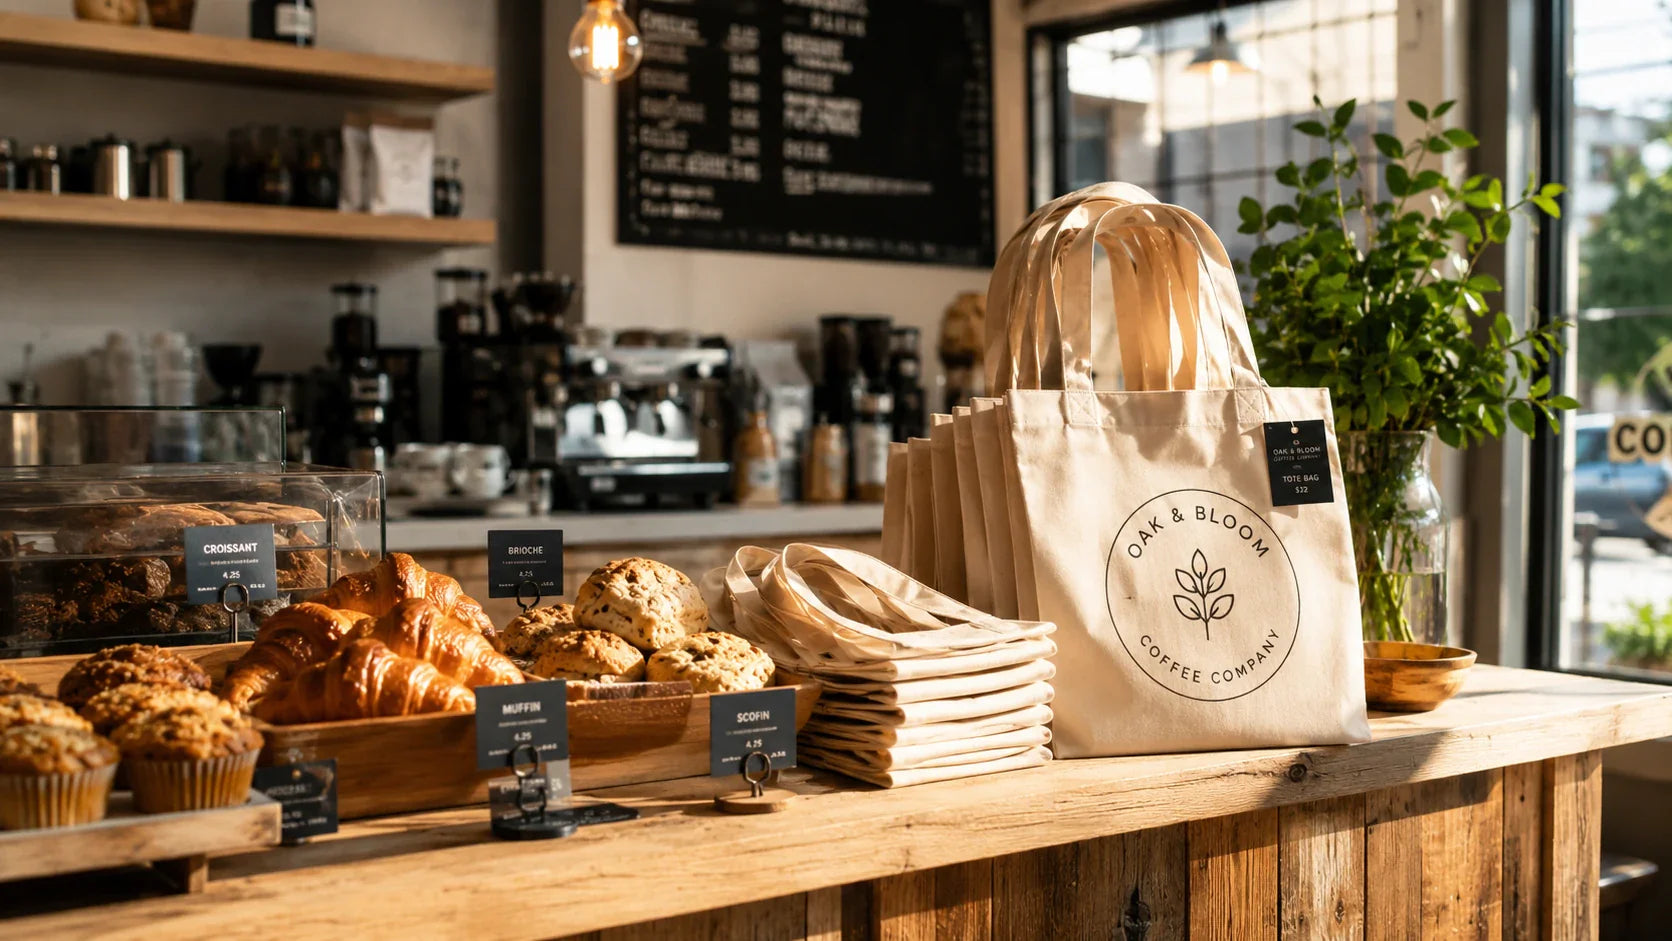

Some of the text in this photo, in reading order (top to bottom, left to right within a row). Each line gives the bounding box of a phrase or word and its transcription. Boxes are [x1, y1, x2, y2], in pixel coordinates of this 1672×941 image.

[1127, 505, 1270, 559] OAK & BLOOM
[203, 542, 258, 554] CROISSANT
[508, 546, 544, 555] BRIOCHE
[1140, 628, 1280, 684] COFFEE COMPANY
[502, 701, 541, 715] MUFFIN
[737, 710, 770, 723] SCOFIN
